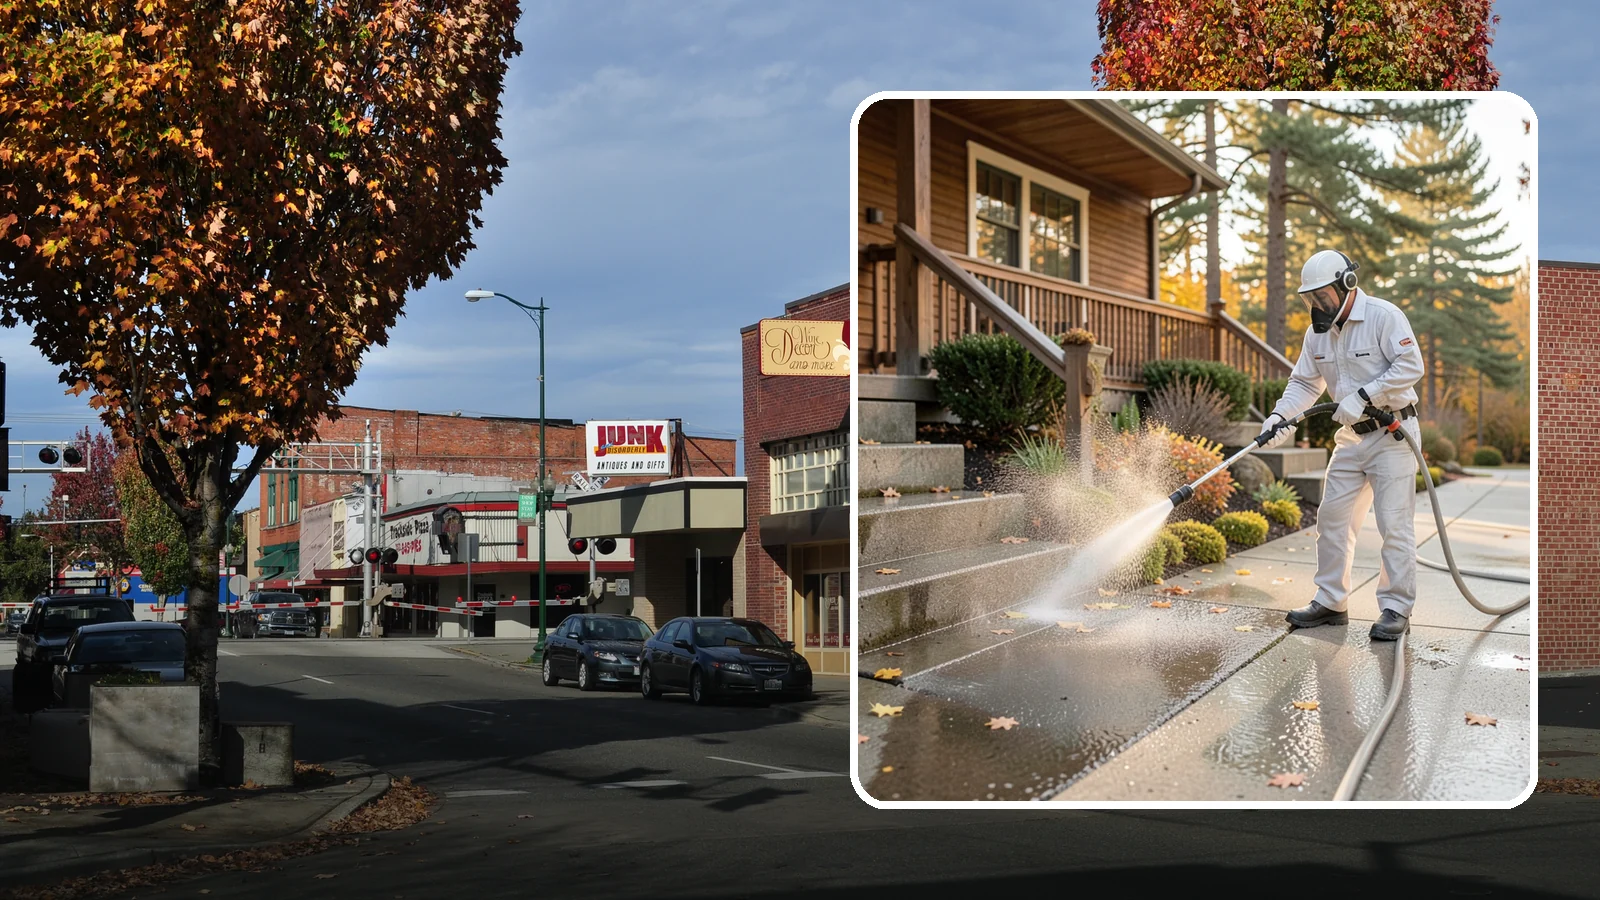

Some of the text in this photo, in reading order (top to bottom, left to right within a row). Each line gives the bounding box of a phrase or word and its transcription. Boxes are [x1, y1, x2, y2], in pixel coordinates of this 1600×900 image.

[595, 425, 666, 457] JUNK
[607, 446, 646, 454] DISORDERLY
[597, 460, 665, 470] ANTIQUES AND GIFTS
[390, 519, 429, 540] Trackside Pizza
